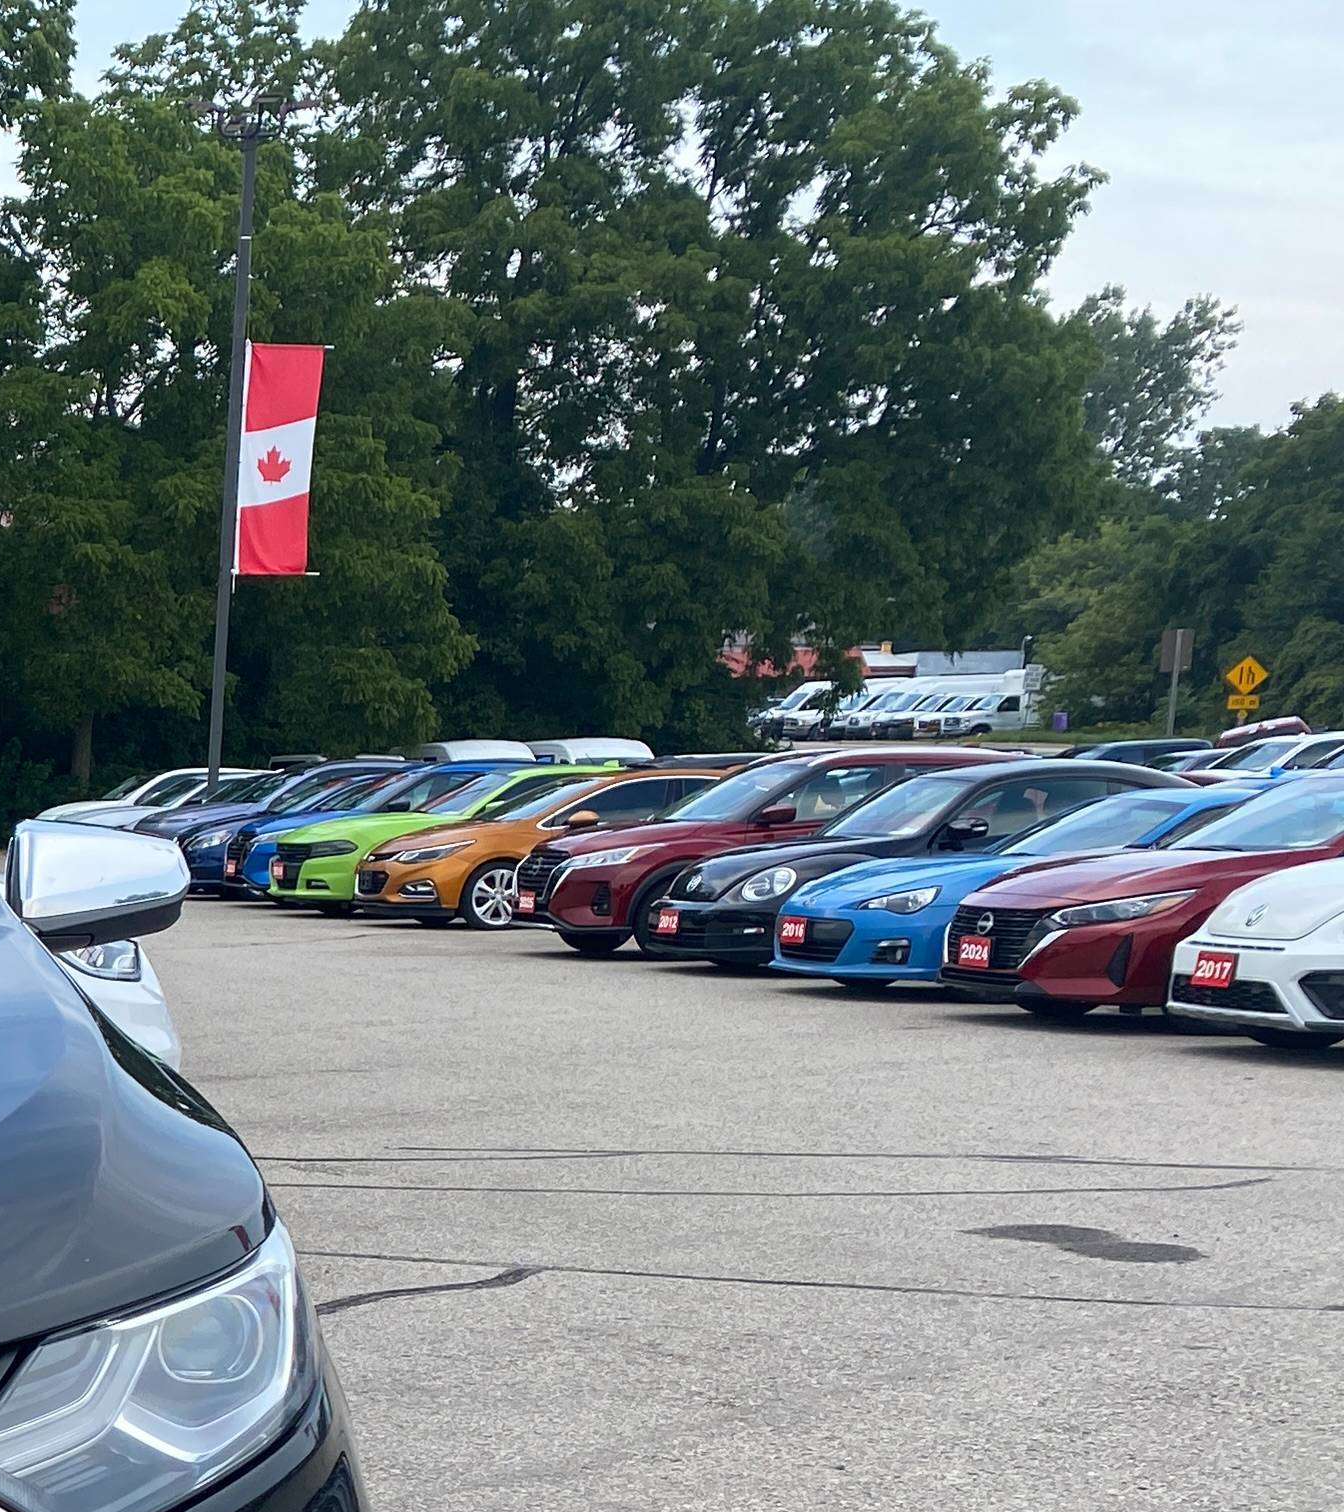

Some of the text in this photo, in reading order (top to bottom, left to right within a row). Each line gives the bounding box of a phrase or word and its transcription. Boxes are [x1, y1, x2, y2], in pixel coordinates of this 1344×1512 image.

[659, 915, 678, 929] 2012
[782, 922, 804, 937] 2016
[961, 943, 988, 960] 2024
[1195, 959, 1232, 979] 2017
